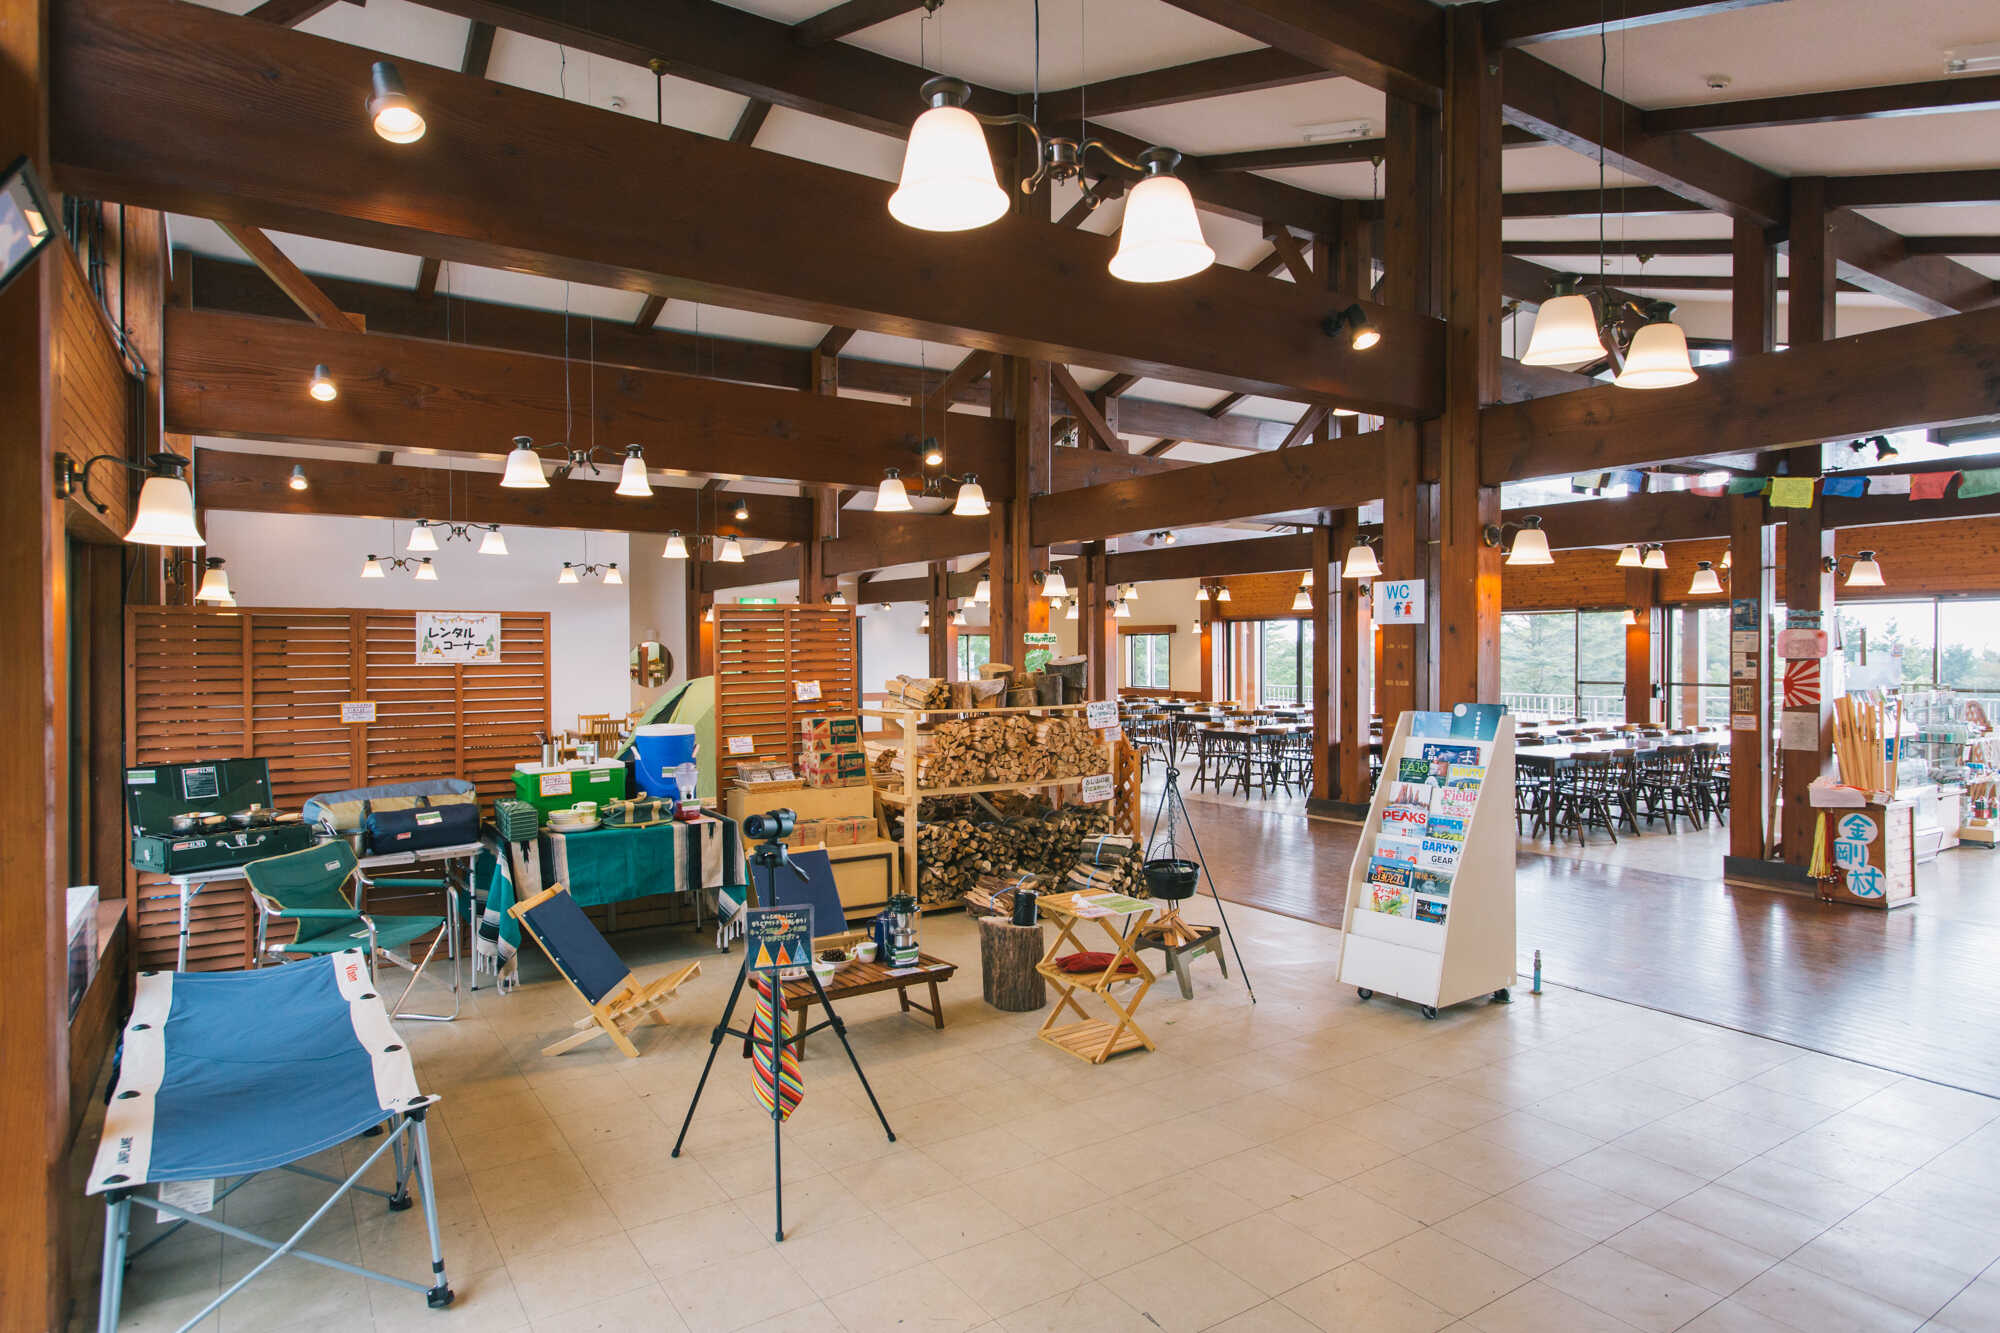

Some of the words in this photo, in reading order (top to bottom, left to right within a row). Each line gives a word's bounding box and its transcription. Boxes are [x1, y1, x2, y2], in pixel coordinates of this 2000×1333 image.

[1386, 584, 1410, 600] WC
[428, 627, 475, 639] レンタル
[443, 640, 485, 650] コーナー
[1452, 767, 1486, 778] BRUTU
[1382, 810, 1427, 825] PEAKS
[1431, 855, 1453, 864] GEAR
[1833, 814, 1883, 897] 金剛杖
